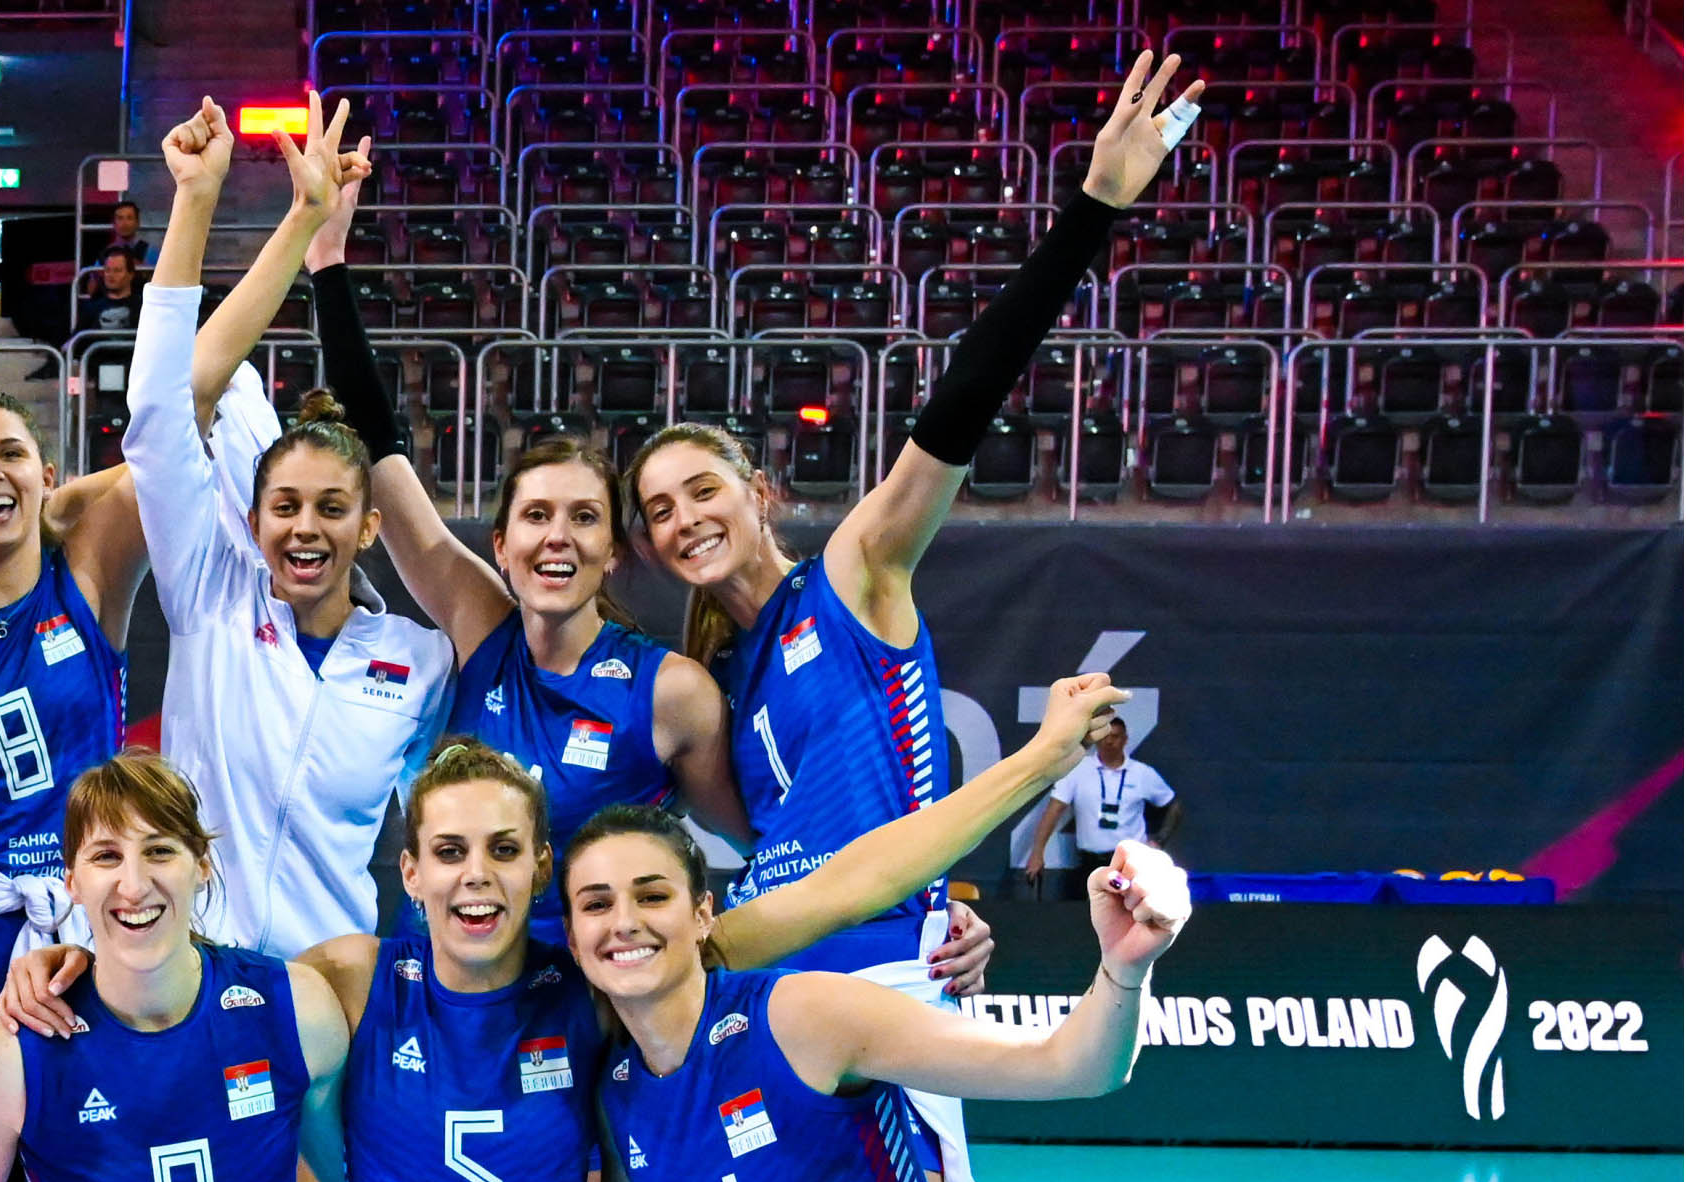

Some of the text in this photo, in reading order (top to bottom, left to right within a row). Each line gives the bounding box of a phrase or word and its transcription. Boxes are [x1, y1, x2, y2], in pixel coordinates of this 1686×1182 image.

[362, 686, 404, 701] SERBIA
[753, 704, 793, 806] 1
[8, 832, 60, 849] БАНКА
[8, 849, 64, 865] ПОШТА
[756, 839, 804, 866] БАНКА
[1246, 996, 1415, 1049] POLAND
[1528, 1000, 1650, 1052] 2022
[392, 1050, 427, 1074] PEAK
[78, 1105, 118, 1124] PEAK
[629, 1154, 649, 1169] EAK
